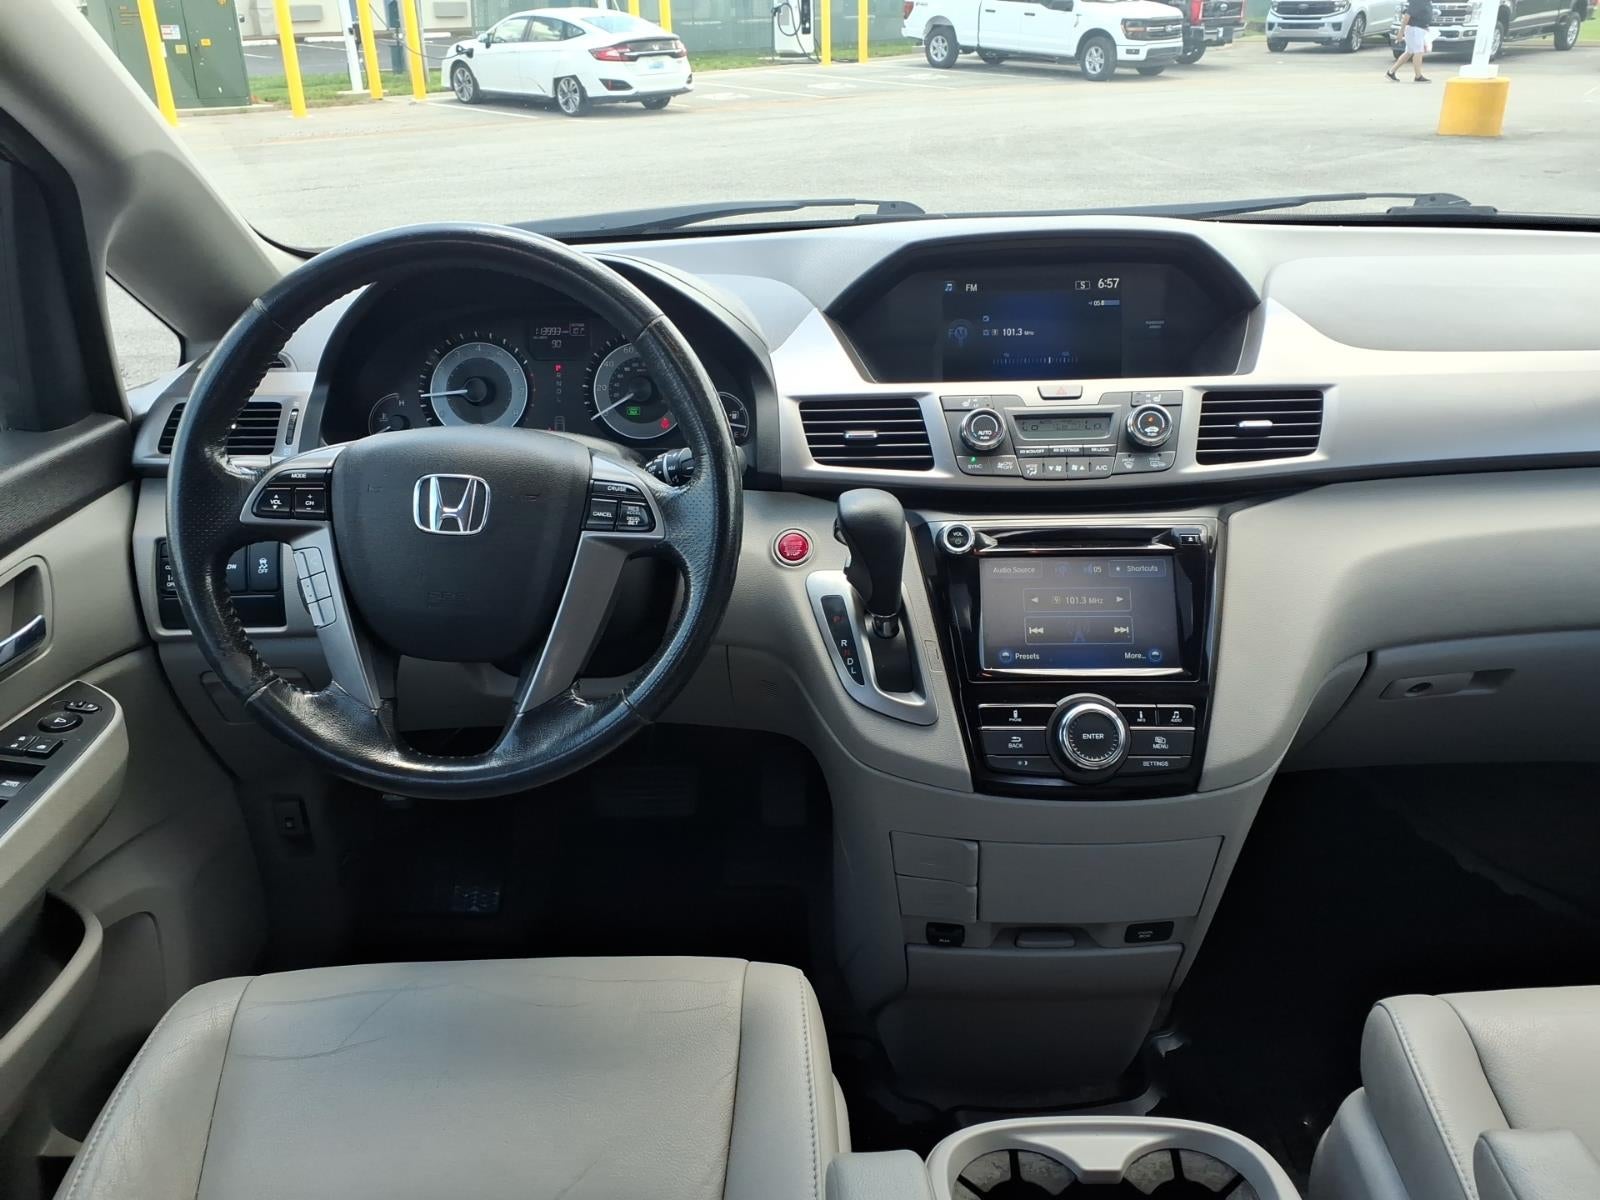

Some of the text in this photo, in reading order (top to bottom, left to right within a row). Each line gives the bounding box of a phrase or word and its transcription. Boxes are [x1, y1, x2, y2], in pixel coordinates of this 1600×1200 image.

[965, 283, 978, 292] FM
[1097, 278, 1120, 289] 6:57
[1002, 328, 1023, 336] 101.3
[993, 566, 1036, 574] Audio Source
[1127, 565, 1159, 573] Shortcuts
[1065, 597, 1087, 605] 101.3
[840, 639, 848, 647] R
[1015, 652, 1040, 661] Presets
